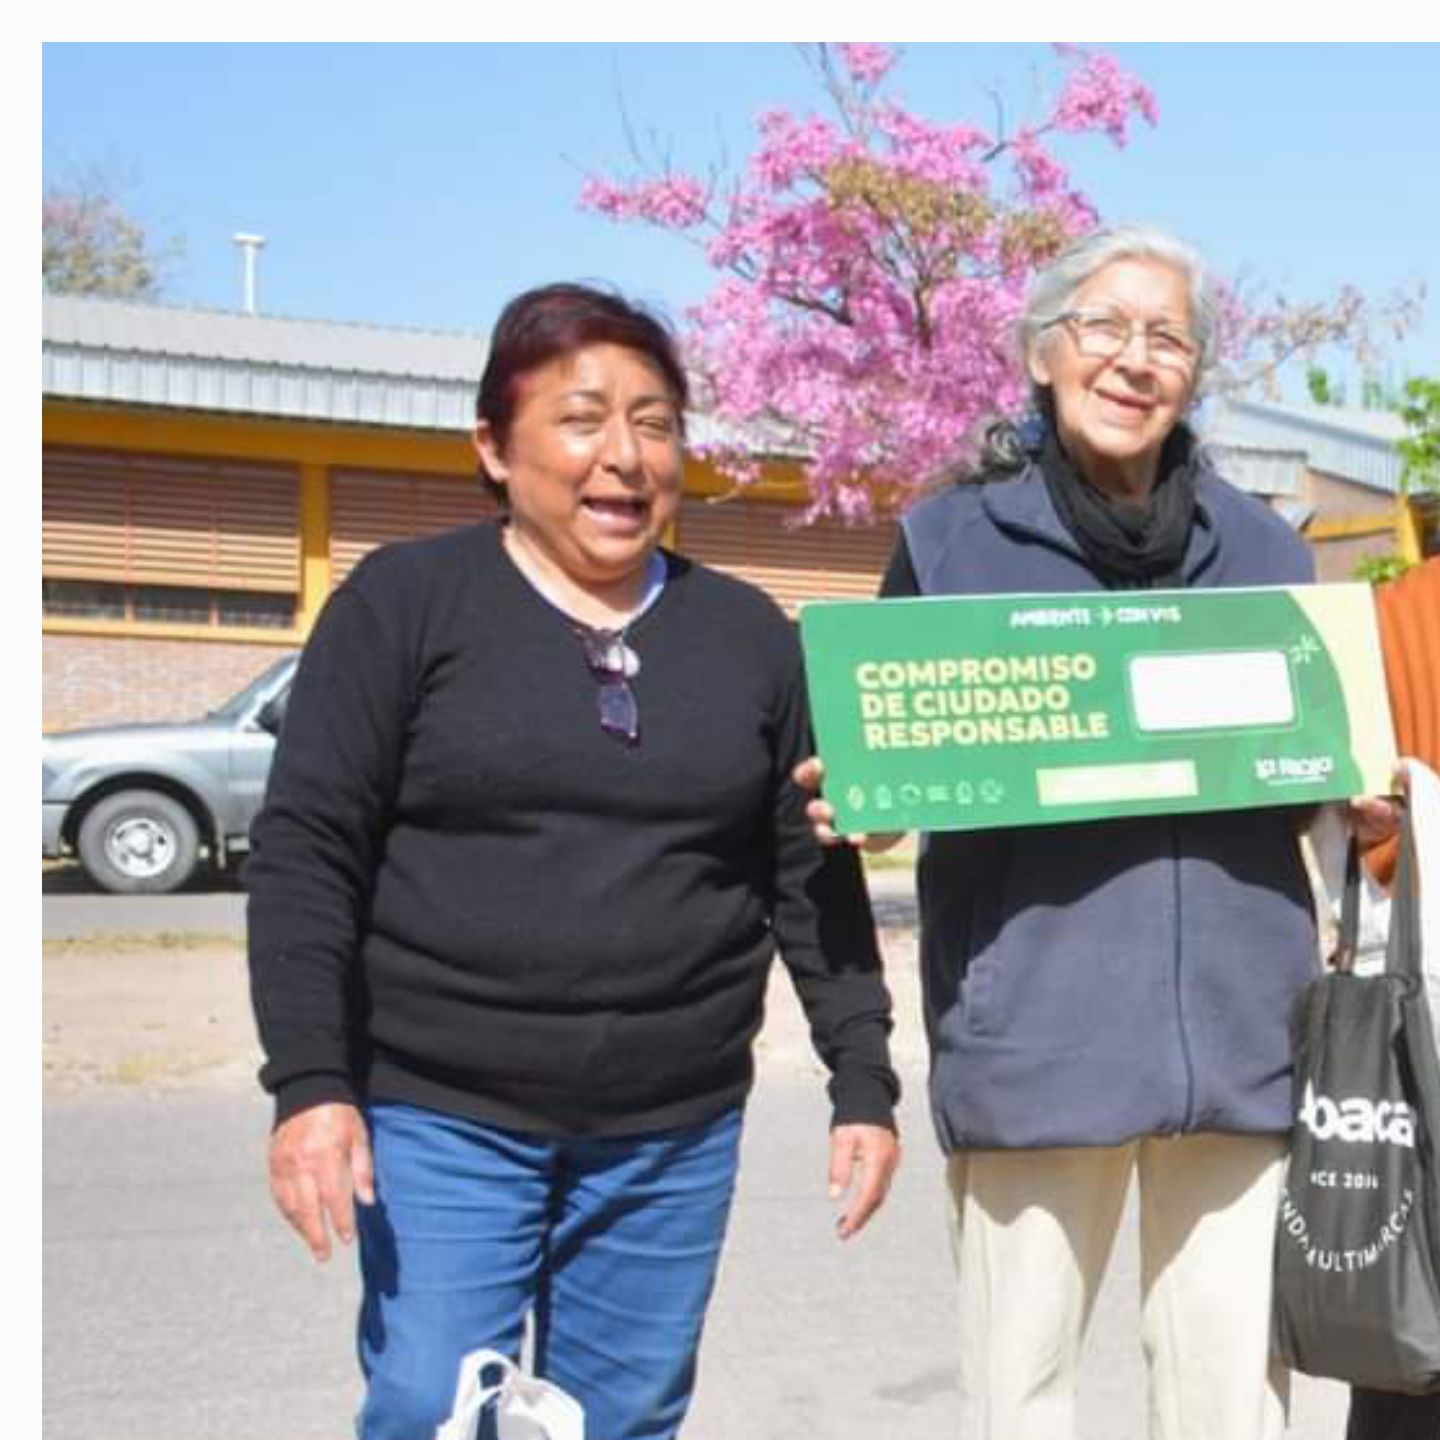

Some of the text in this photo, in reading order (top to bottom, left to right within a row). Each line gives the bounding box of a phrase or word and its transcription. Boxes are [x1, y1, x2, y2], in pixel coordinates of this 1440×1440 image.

[856, 653, 1096, 688] COMPROMISO
[861, 684, 1070, 719] DE CIUDADO
[865, 712, 1110, 749] RESPONSABLE
